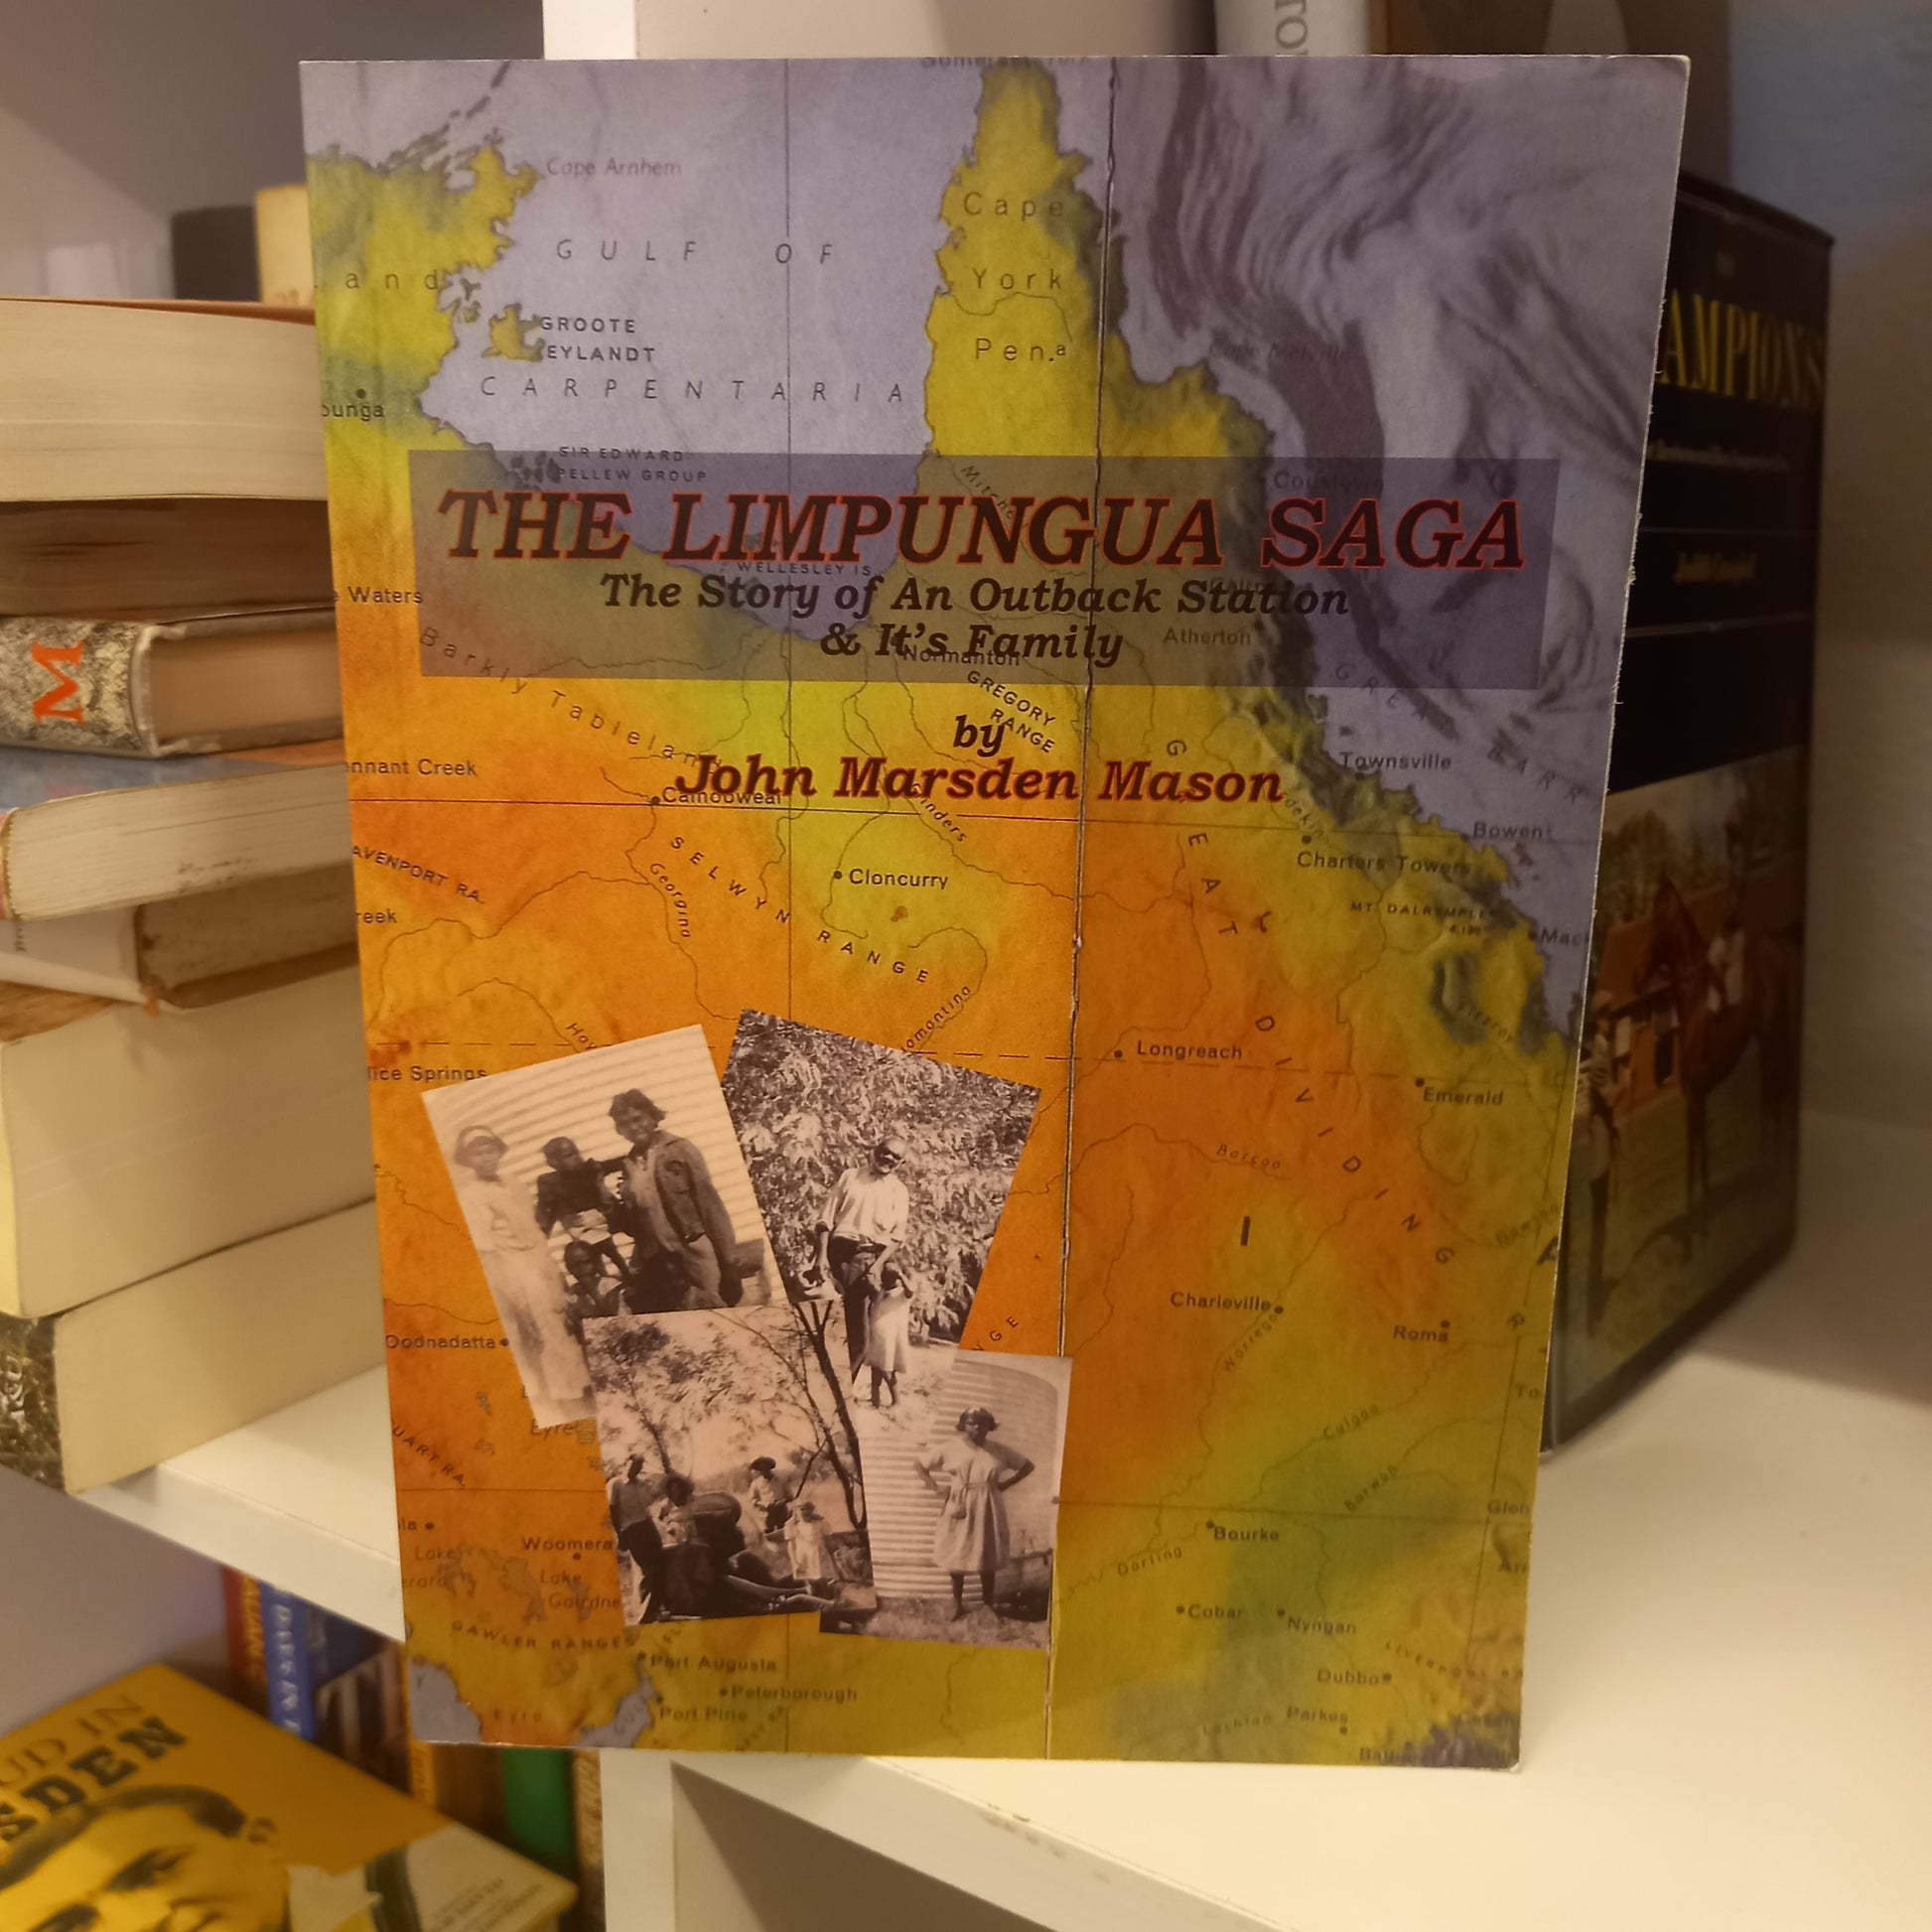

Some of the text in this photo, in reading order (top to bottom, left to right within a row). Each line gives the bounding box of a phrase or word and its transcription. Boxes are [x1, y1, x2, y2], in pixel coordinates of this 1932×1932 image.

[547, 156, 682, 179] Cape Arnhem
[964, 192, 1064, 221] Cape
[557, 238, 833, 265] GULF OF
[315, 269, 444, 290] and
[972, 268, 1063, 291] York
[540, 316, 637, 334] GROOTE
[546, 345, 656, 362] EYLANDT
[480, 375, 903, 403] CARPENTARIA
[558, 446, 685, 463] SIR EDWARD
[641, 470, 708, 483] GROUP
[437, 487, 1527, 571] THE LIMPUNGUA SAGA
[738, 562, 845, 576] WELLESLEY
[346, 585, 424, 604] Waters
[600, 572, 682, 609] The
[697, 574, 820, 620] Story
[834, 575, 886, 621] of
[891, 576, 954, 612] An
[969, 577, 1162, 615] Outback
[1176, 579, 1349, 616] Station
[820, 621, 861, 656] &
[968, 623, 1123, 668] Family
[1163, 626, 1251, 645] Atherton
[32, 641, 86, 727] M
[419, 625, 722, 774] Barkly Tablelan
[968, 670, 1056, 727] GREGORY
[953, 714, 1006, 759] by
[990, 708, 1056, 755] RANGE
[418, 758, 479, 776] Creek
[1339, 751, 1452, 770] Townsville
[675, 753, 1285, 803] John Marsden Mason
[351, 845, 449, 888] AVENPORT
[1297, 850, 1385, 871] Charters
[849, 868, 950, 891] Cloncurry
[670, 836, 930, 984] SELWYN RANGE
[1137, 1039, 1243, 1061] Longreach
[410, 1064, 488, 1083] Springs
[1422, 1085, 1505, 1107] Emerald
[1170, 1292, 1272, 1313] Charleville
[384, 1333, 496, 1350] Oodnadatta
[1392, 1324, 1449, 1343] Roma
[521, 1535, 614, 1553] Woomera
[1212, 1527, 1280, 1543] Bourke
[1187, 1603, 1245, 1620] Cobar
[1287, 1616, 1357, 1637] Nyngan
[698, 1655, 776, 1674] Augusta
[1315, 1668, 1380, 1686] Dubbo
[731, 1687, 858, 1705] Peterborough
